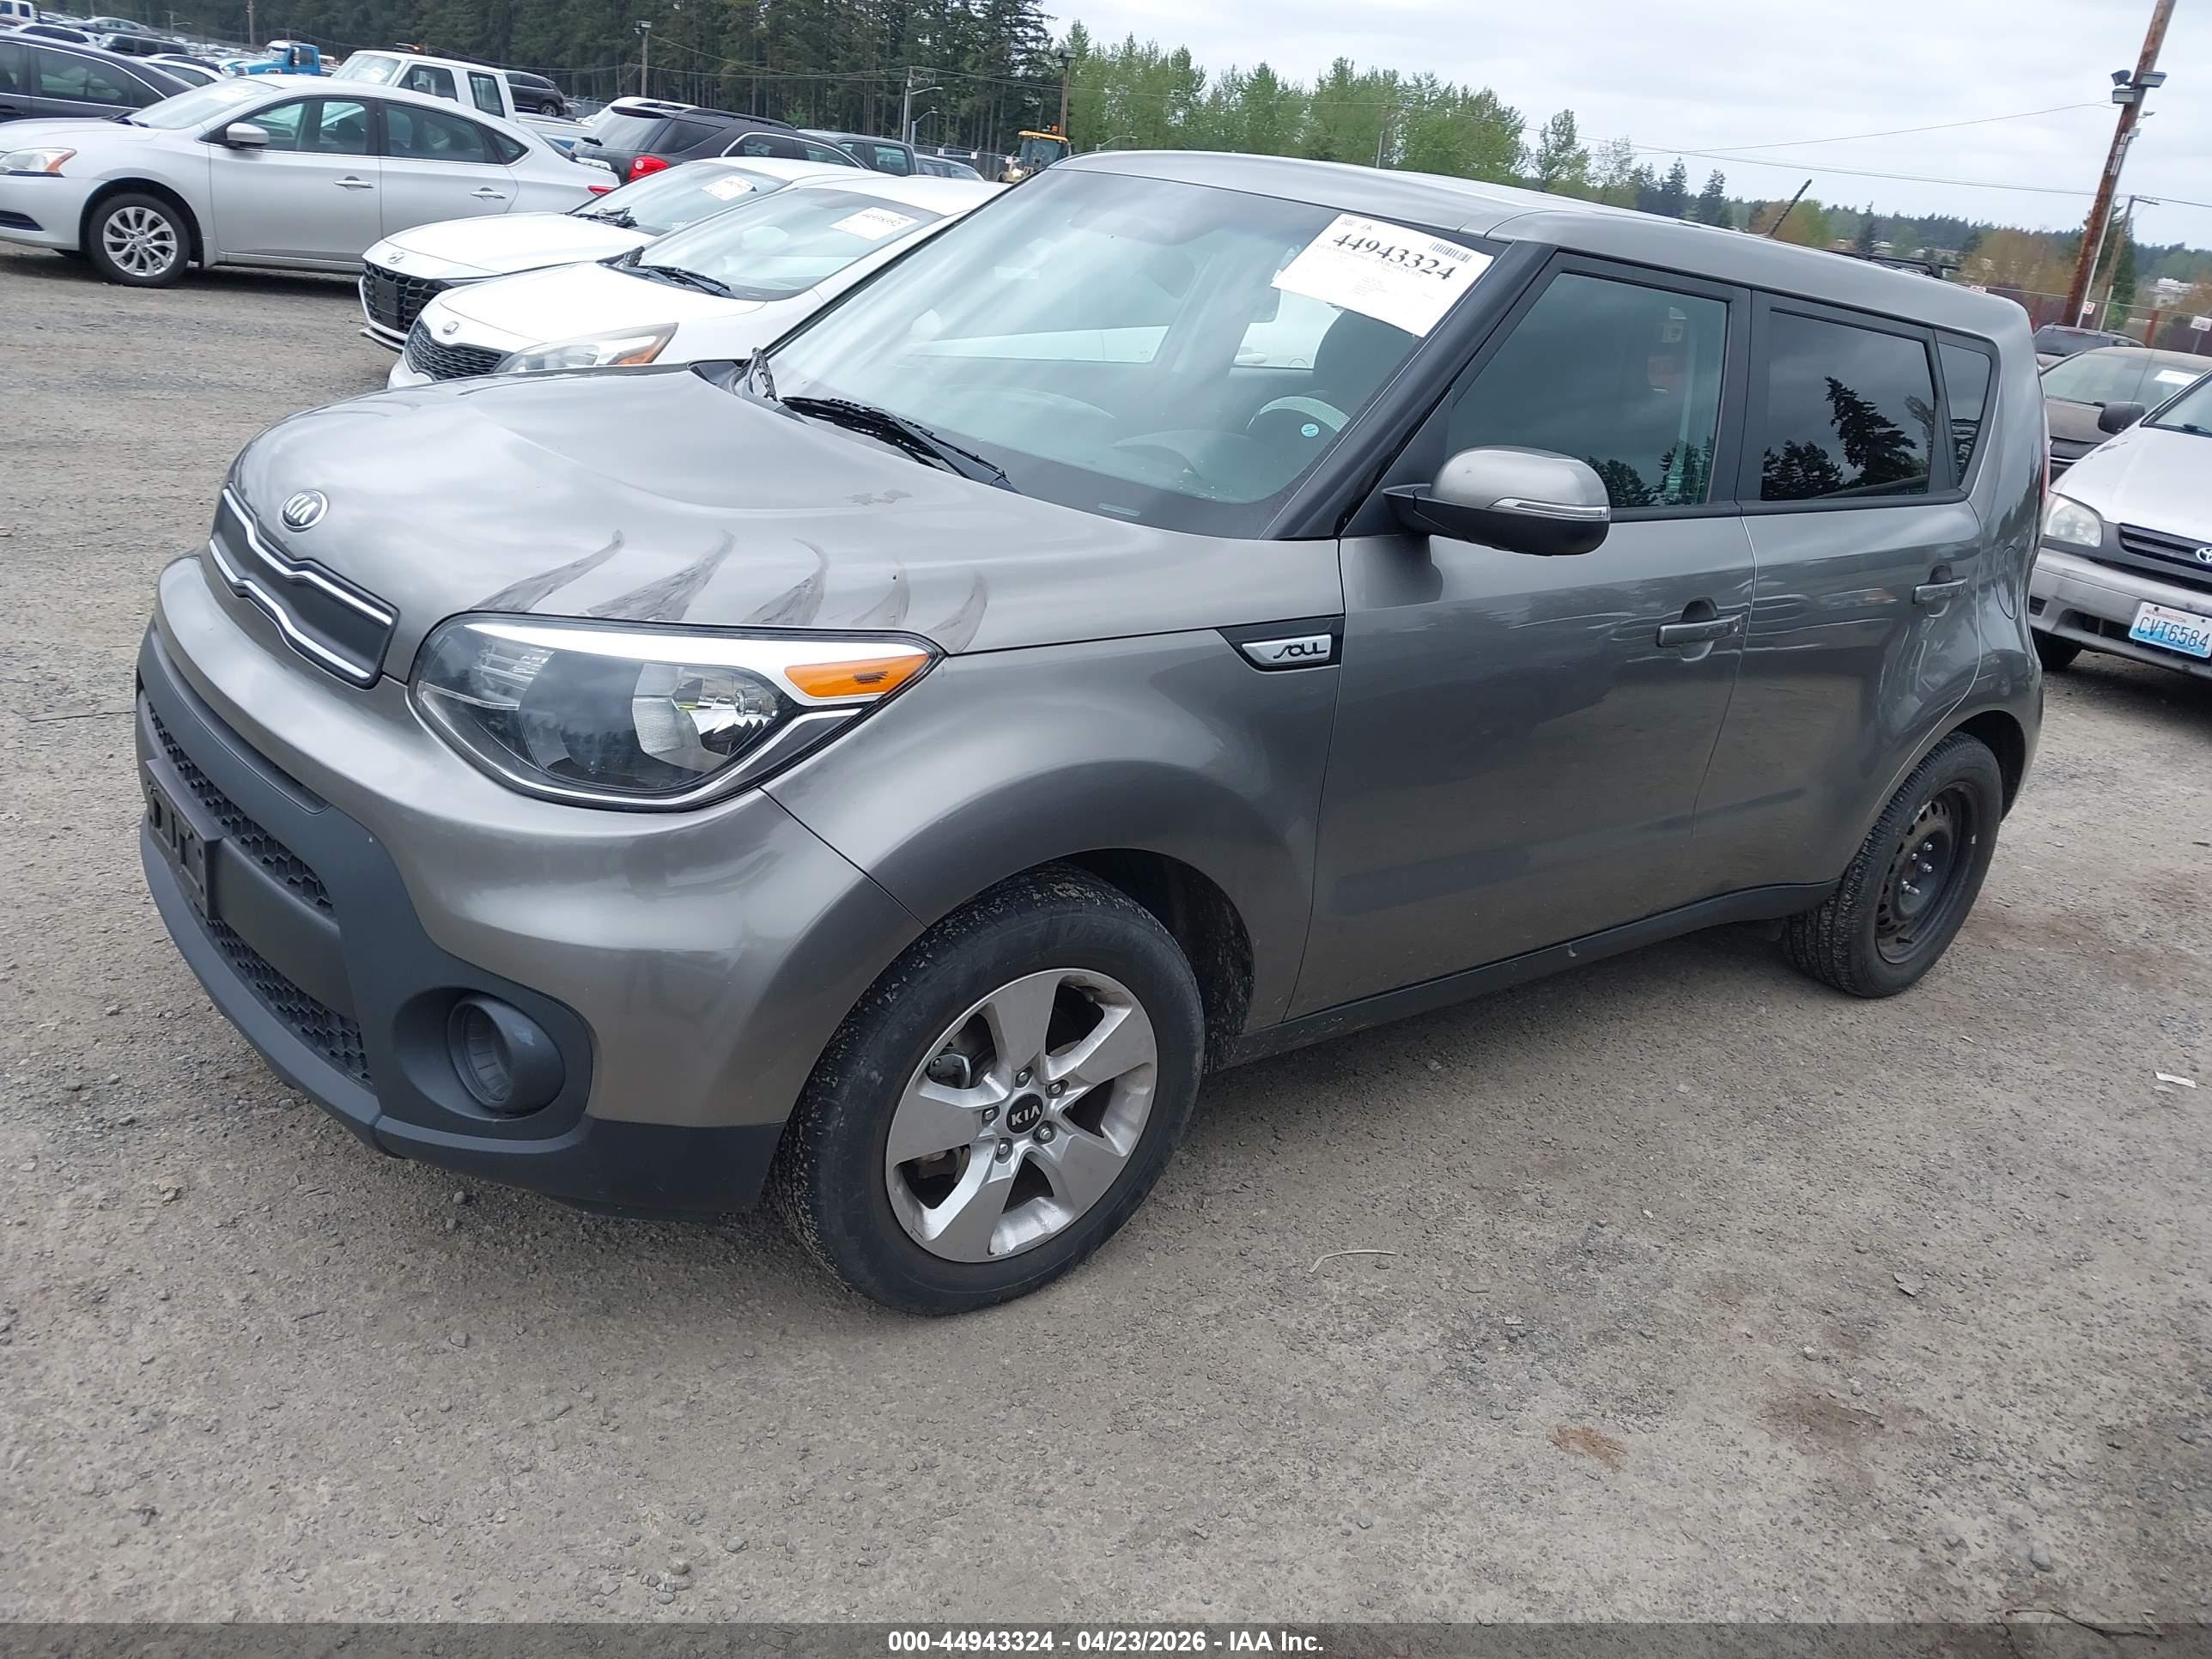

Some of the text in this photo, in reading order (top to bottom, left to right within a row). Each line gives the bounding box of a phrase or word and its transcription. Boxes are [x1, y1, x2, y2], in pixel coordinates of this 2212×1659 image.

[1333, 233, 1457, 281] 44943324
[2084, 302, 2094, 313] 9
[2137, 616, 2210, 650] CVT6584
[1012, 1104, 1041, 1127] KIA
